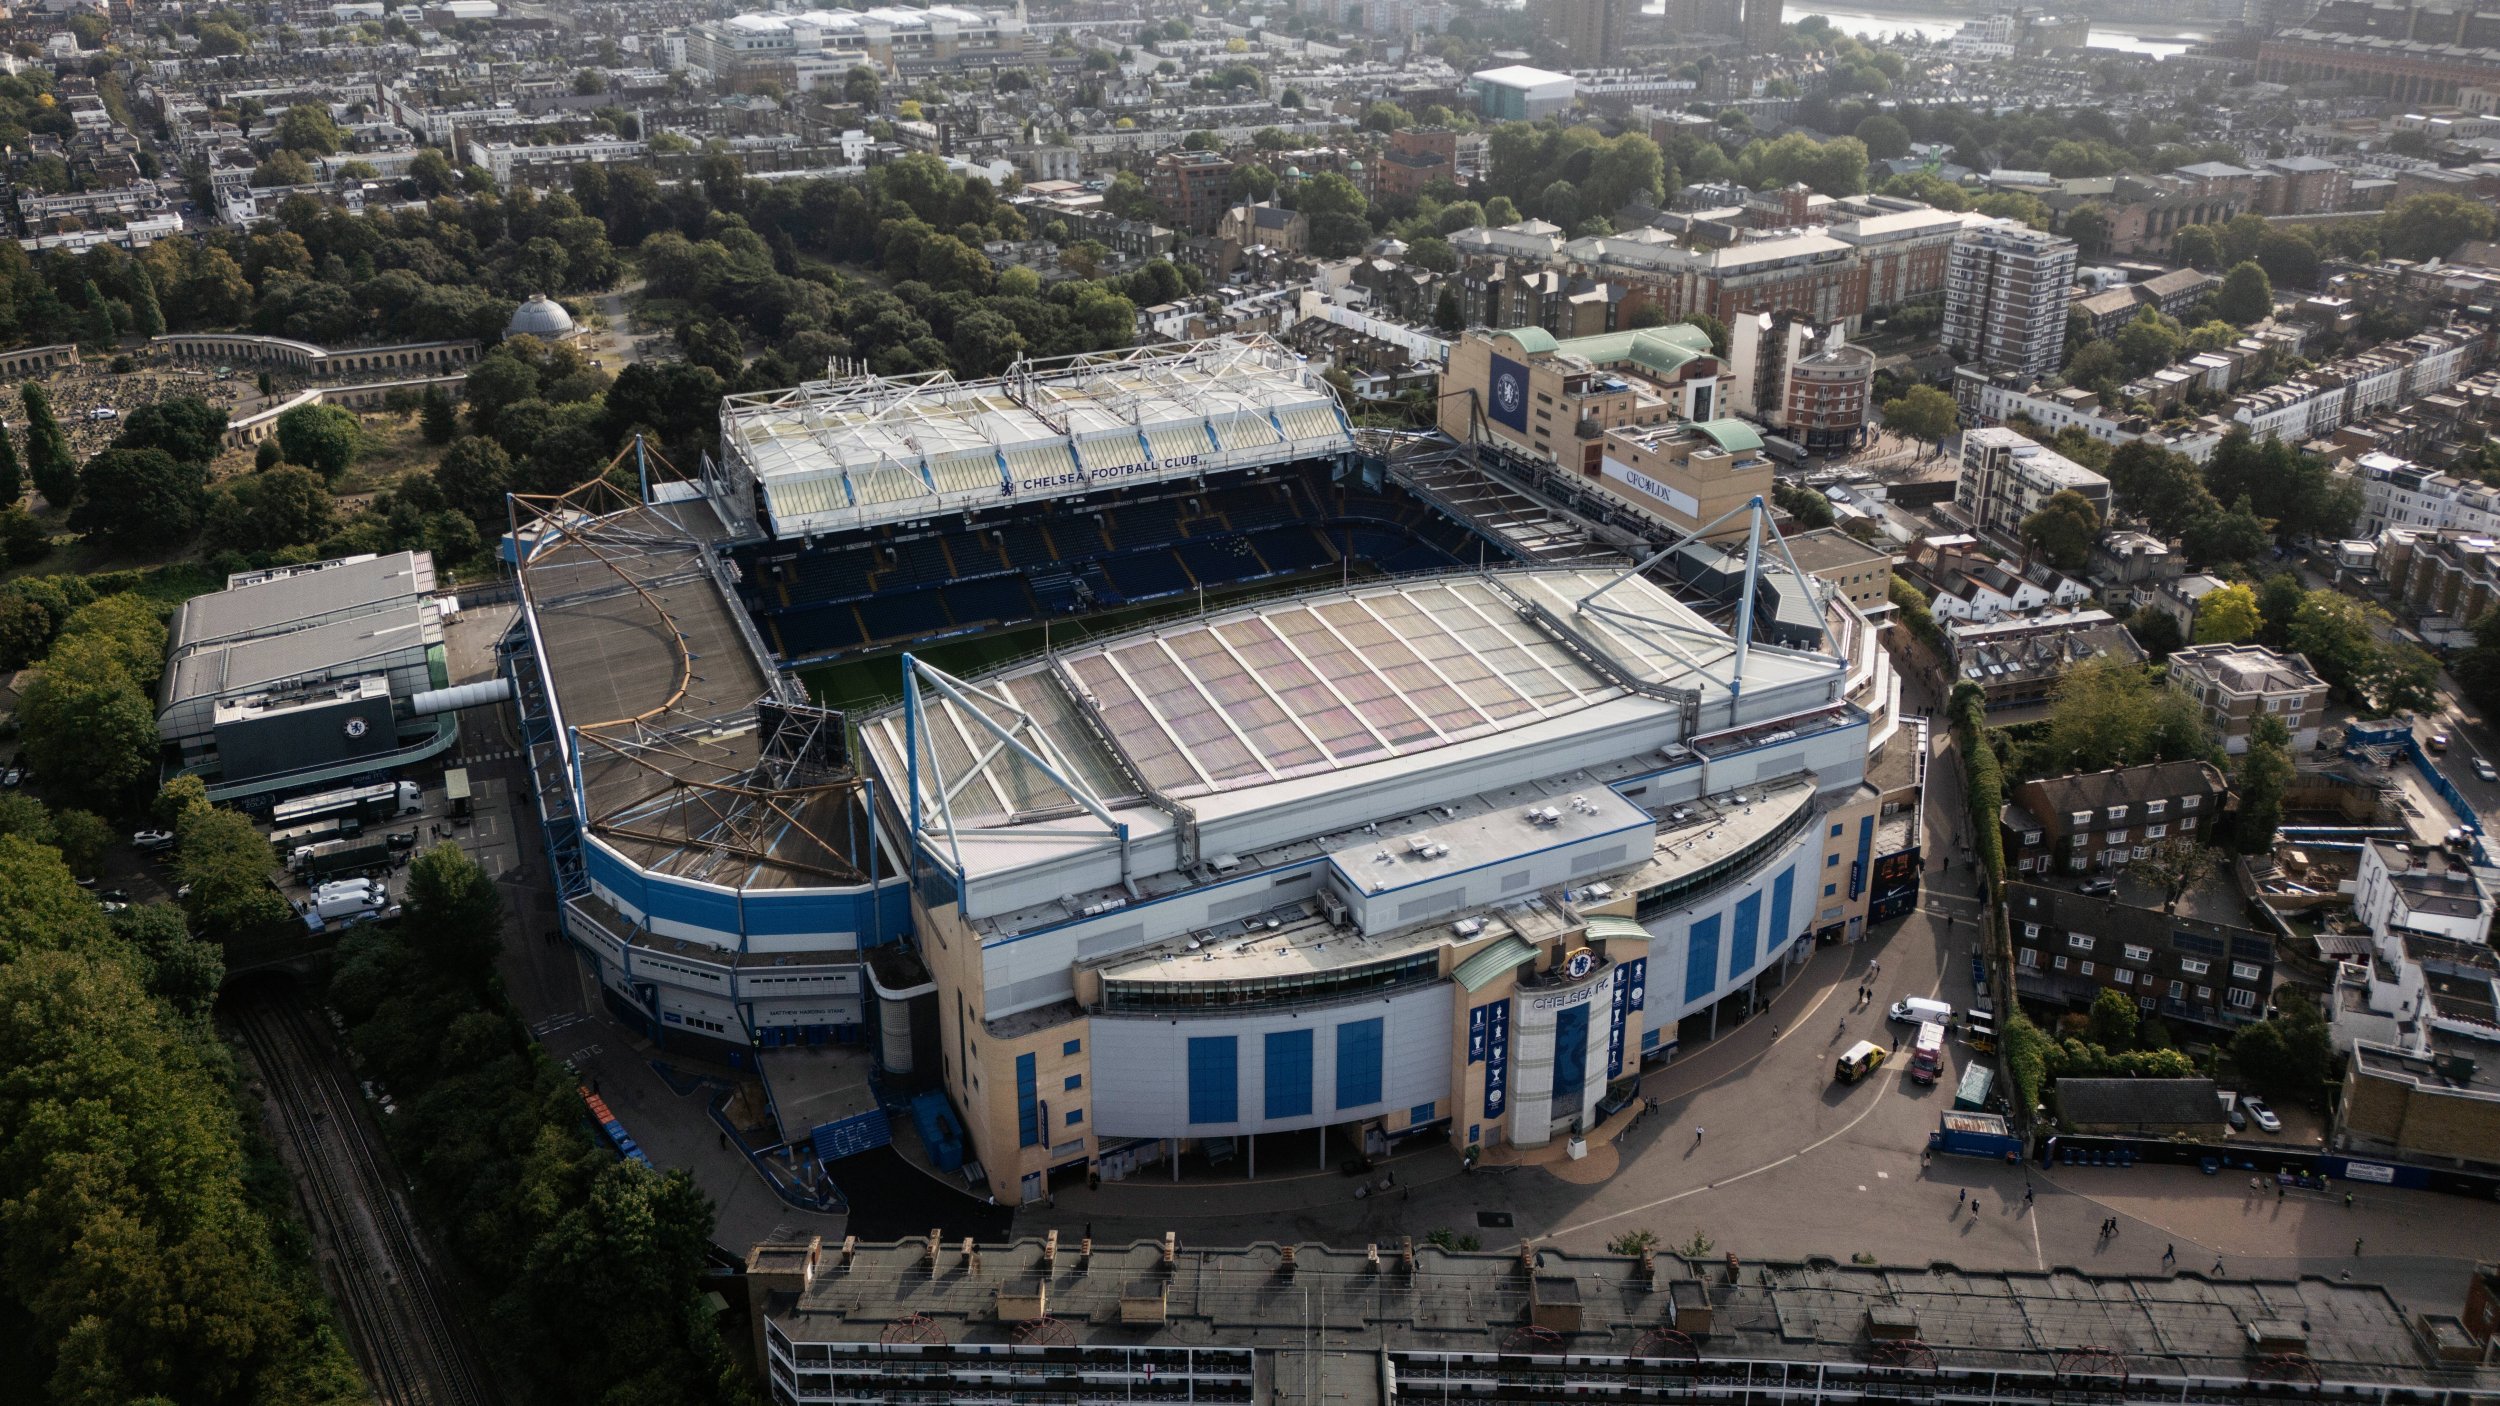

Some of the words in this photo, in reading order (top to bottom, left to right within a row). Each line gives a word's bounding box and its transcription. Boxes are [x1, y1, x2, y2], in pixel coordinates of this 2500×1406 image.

[1023, 472, 1085, 490] CHELSEA
[1091, 461, 1158, 479] FOOTBALL
[1165, 455, 1198, 468] CLUB
[1626, 471, 1645, 489] CFC
[1651, 482, 1671, 501] LDN
[1533, 988, 1593, 1010] CHELSEA
[1595, 978, 1609, 996] FC
[755, 1029, 762, 1037] 8
